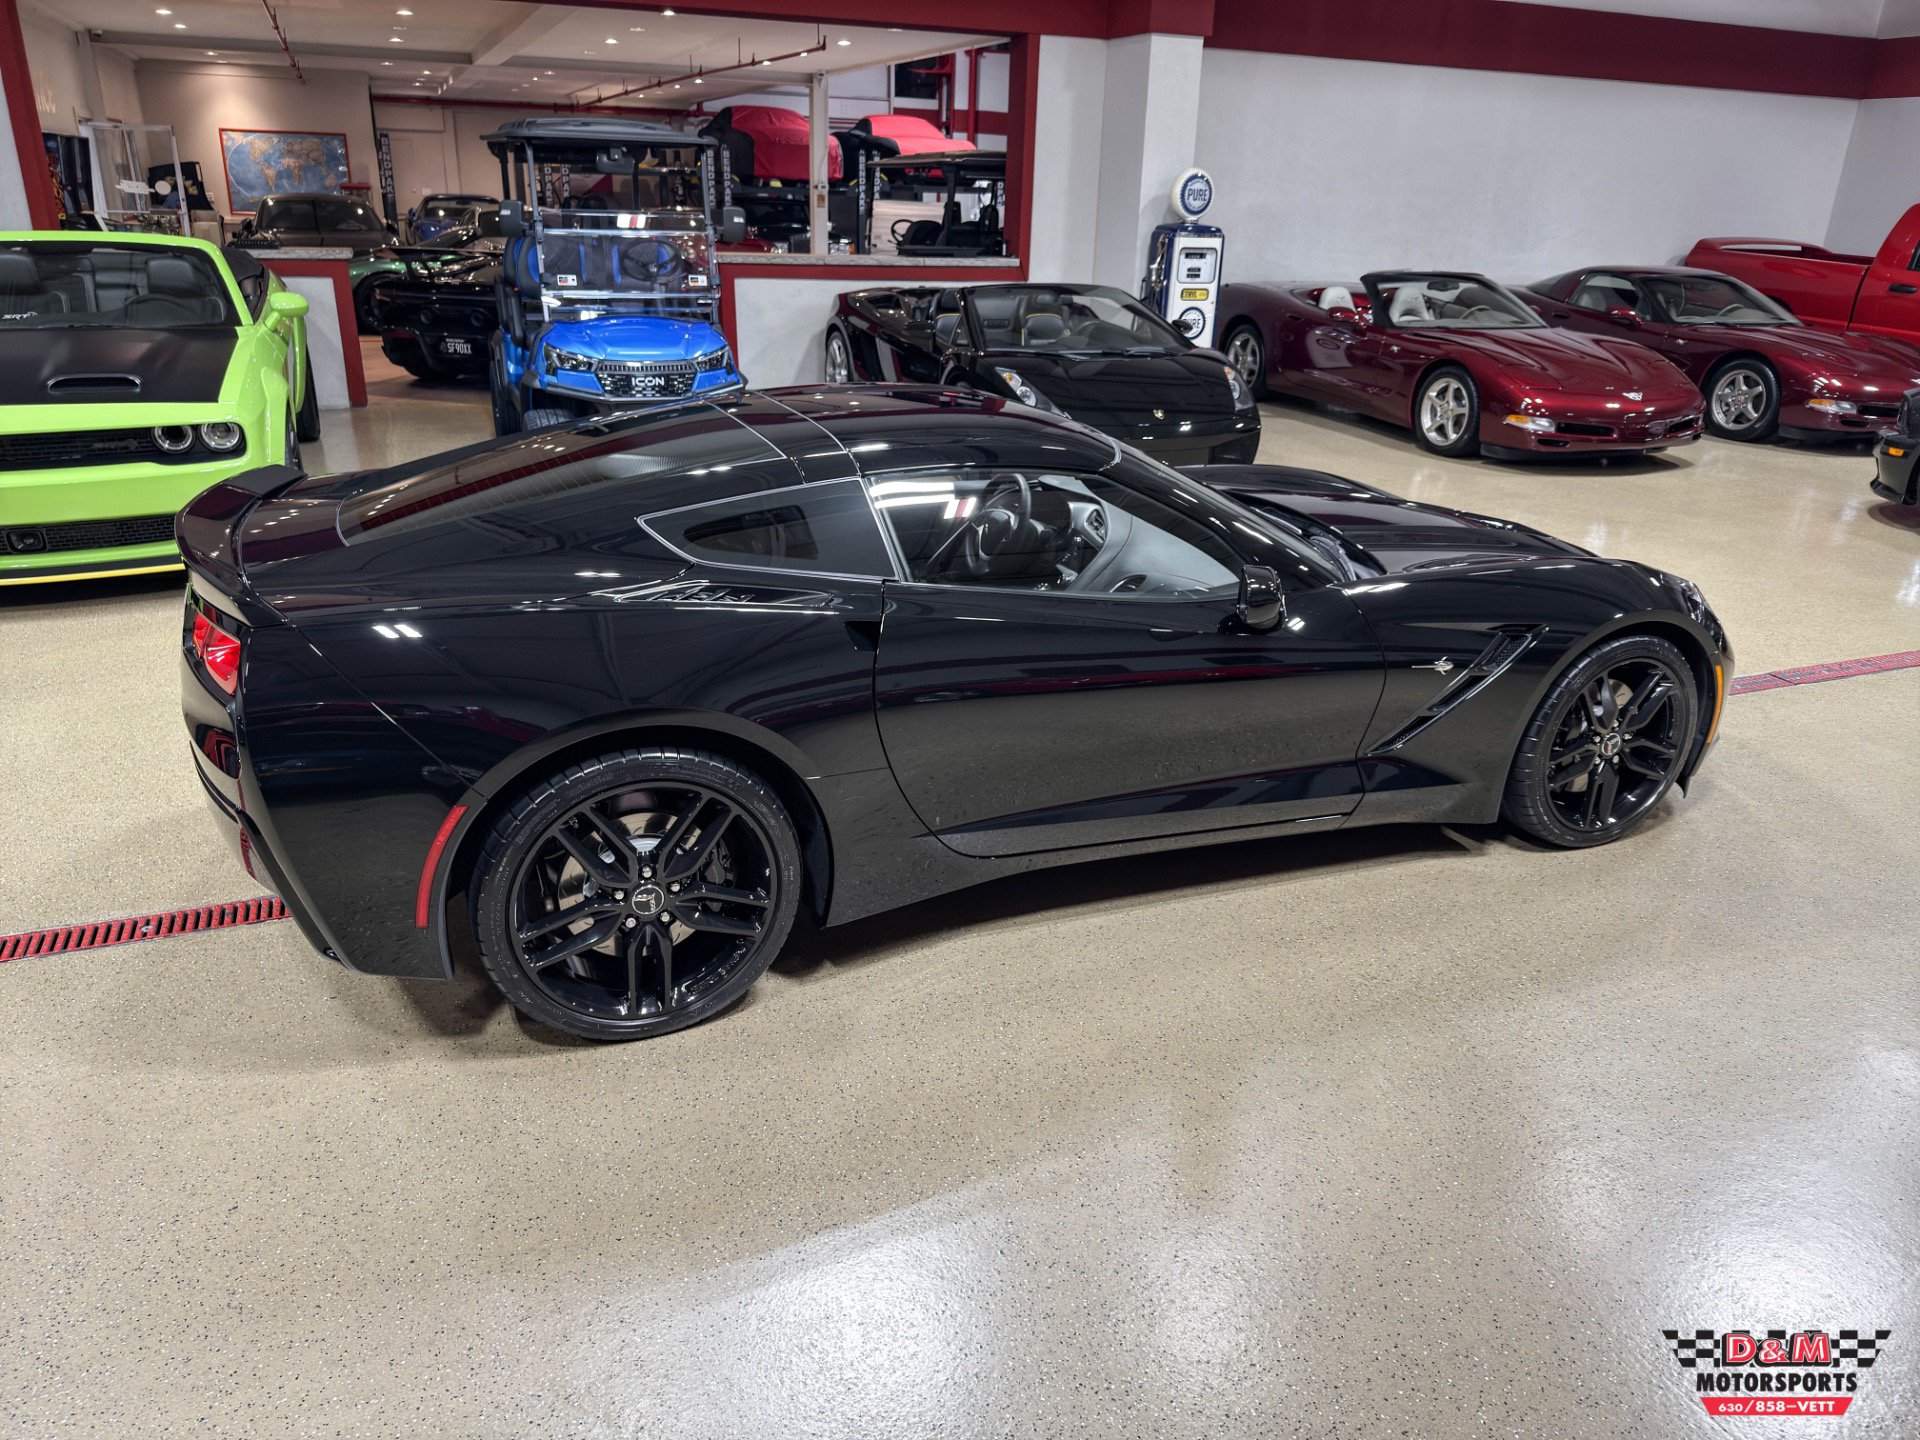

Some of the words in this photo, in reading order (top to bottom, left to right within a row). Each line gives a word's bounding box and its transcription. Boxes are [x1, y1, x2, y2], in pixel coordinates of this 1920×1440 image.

[1186, 188, 1208, 202] PURE
[447, 342, 472, 355] SF90XX
[631, 376, 665, 387] ICON
